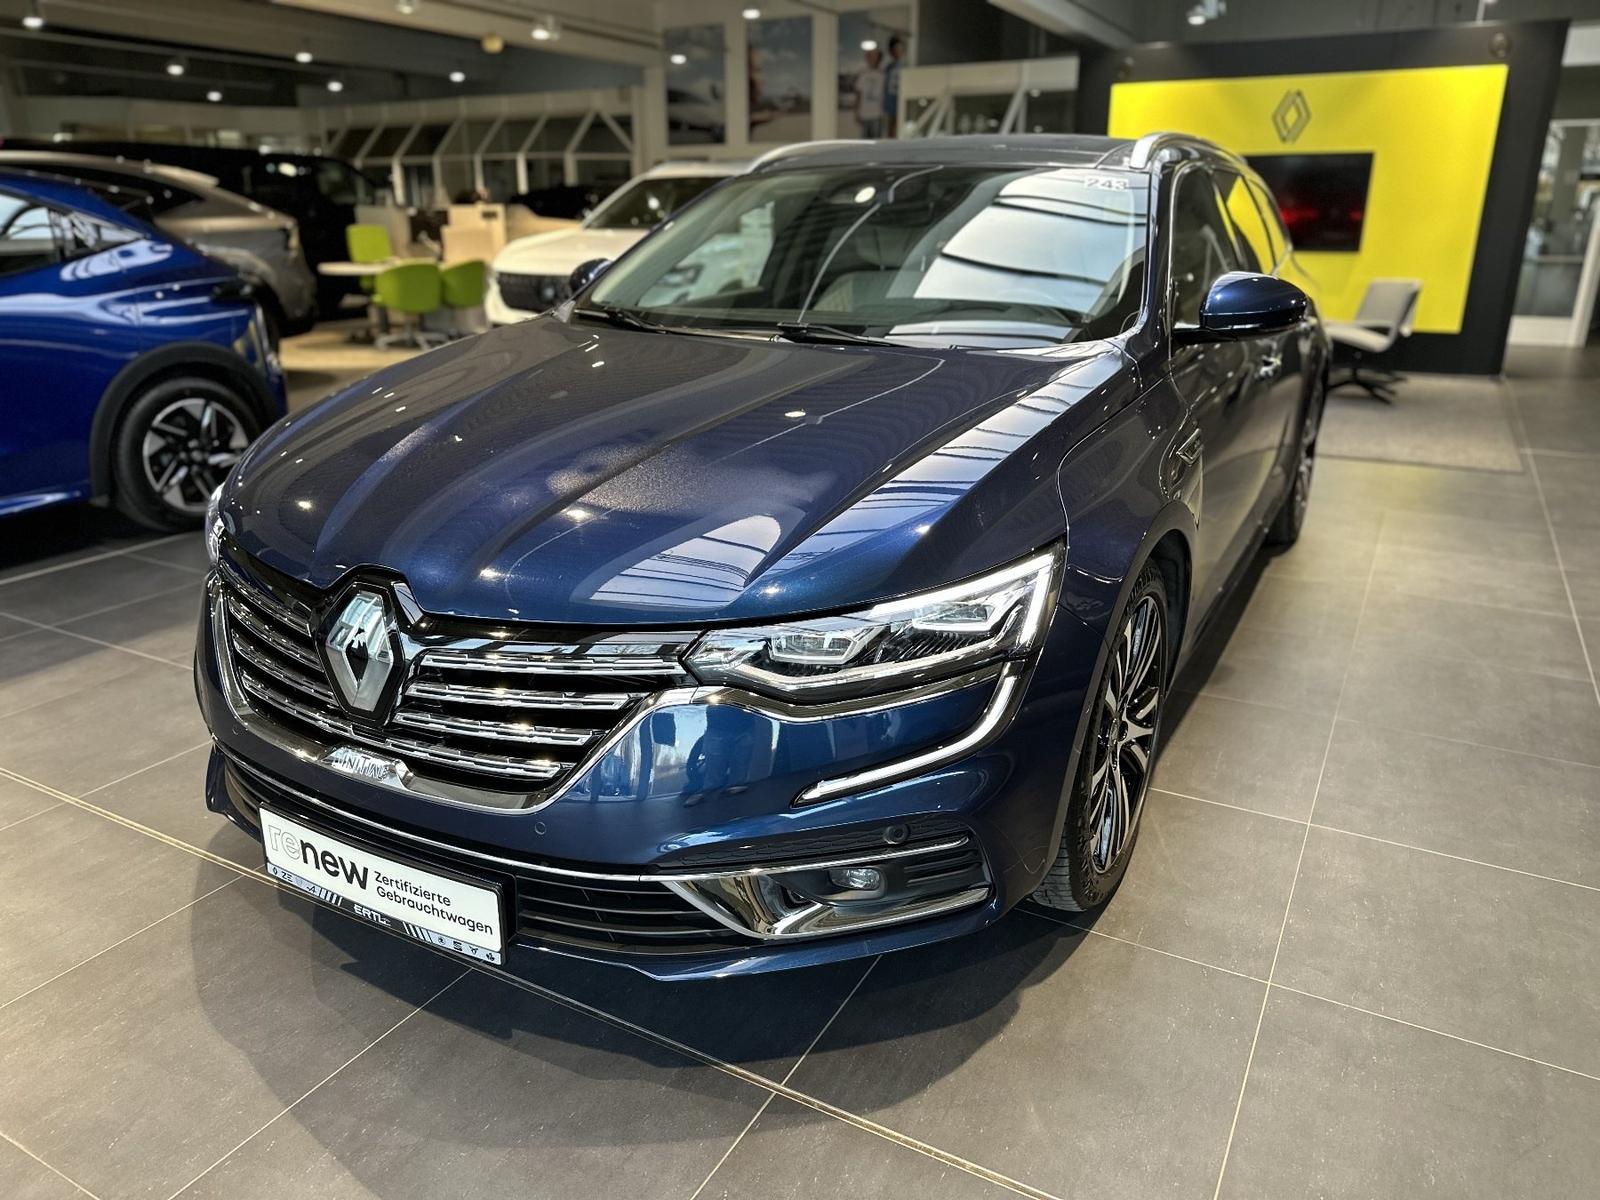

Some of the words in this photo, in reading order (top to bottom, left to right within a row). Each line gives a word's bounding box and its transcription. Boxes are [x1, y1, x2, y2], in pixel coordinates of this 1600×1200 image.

[268, 825, 368, 890] renew
[374, 871, 451, 906] Zertifizierte
[376, 886, 493, 935] Gebrauchtwagen
